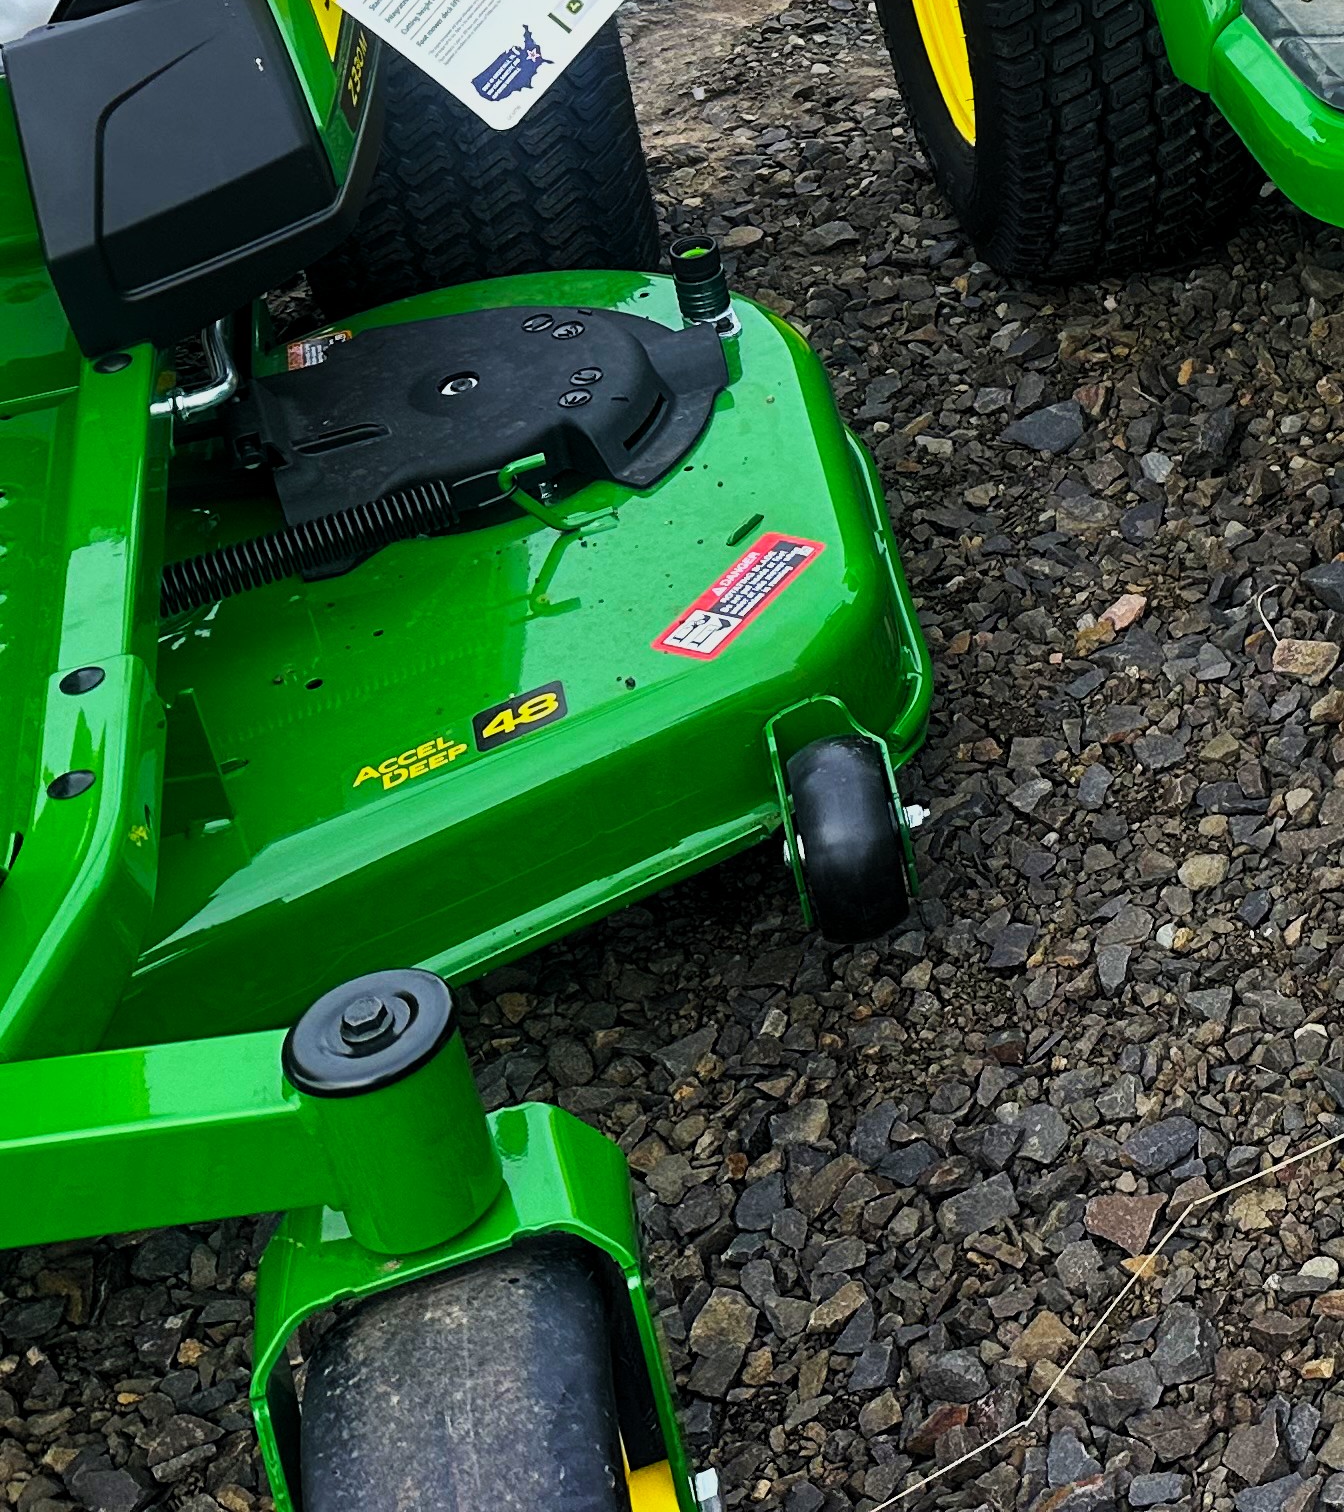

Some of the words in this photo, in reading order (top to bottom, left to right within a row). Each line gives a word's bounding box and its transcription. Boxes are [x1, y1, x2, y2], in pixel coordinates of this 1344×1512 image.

[719, 551, 760, 587] DANGER
[482, 692, 559, 739] 48
[352, 736, 455, 788] ACCEL
[382, 743, 468, 791] DEEP
